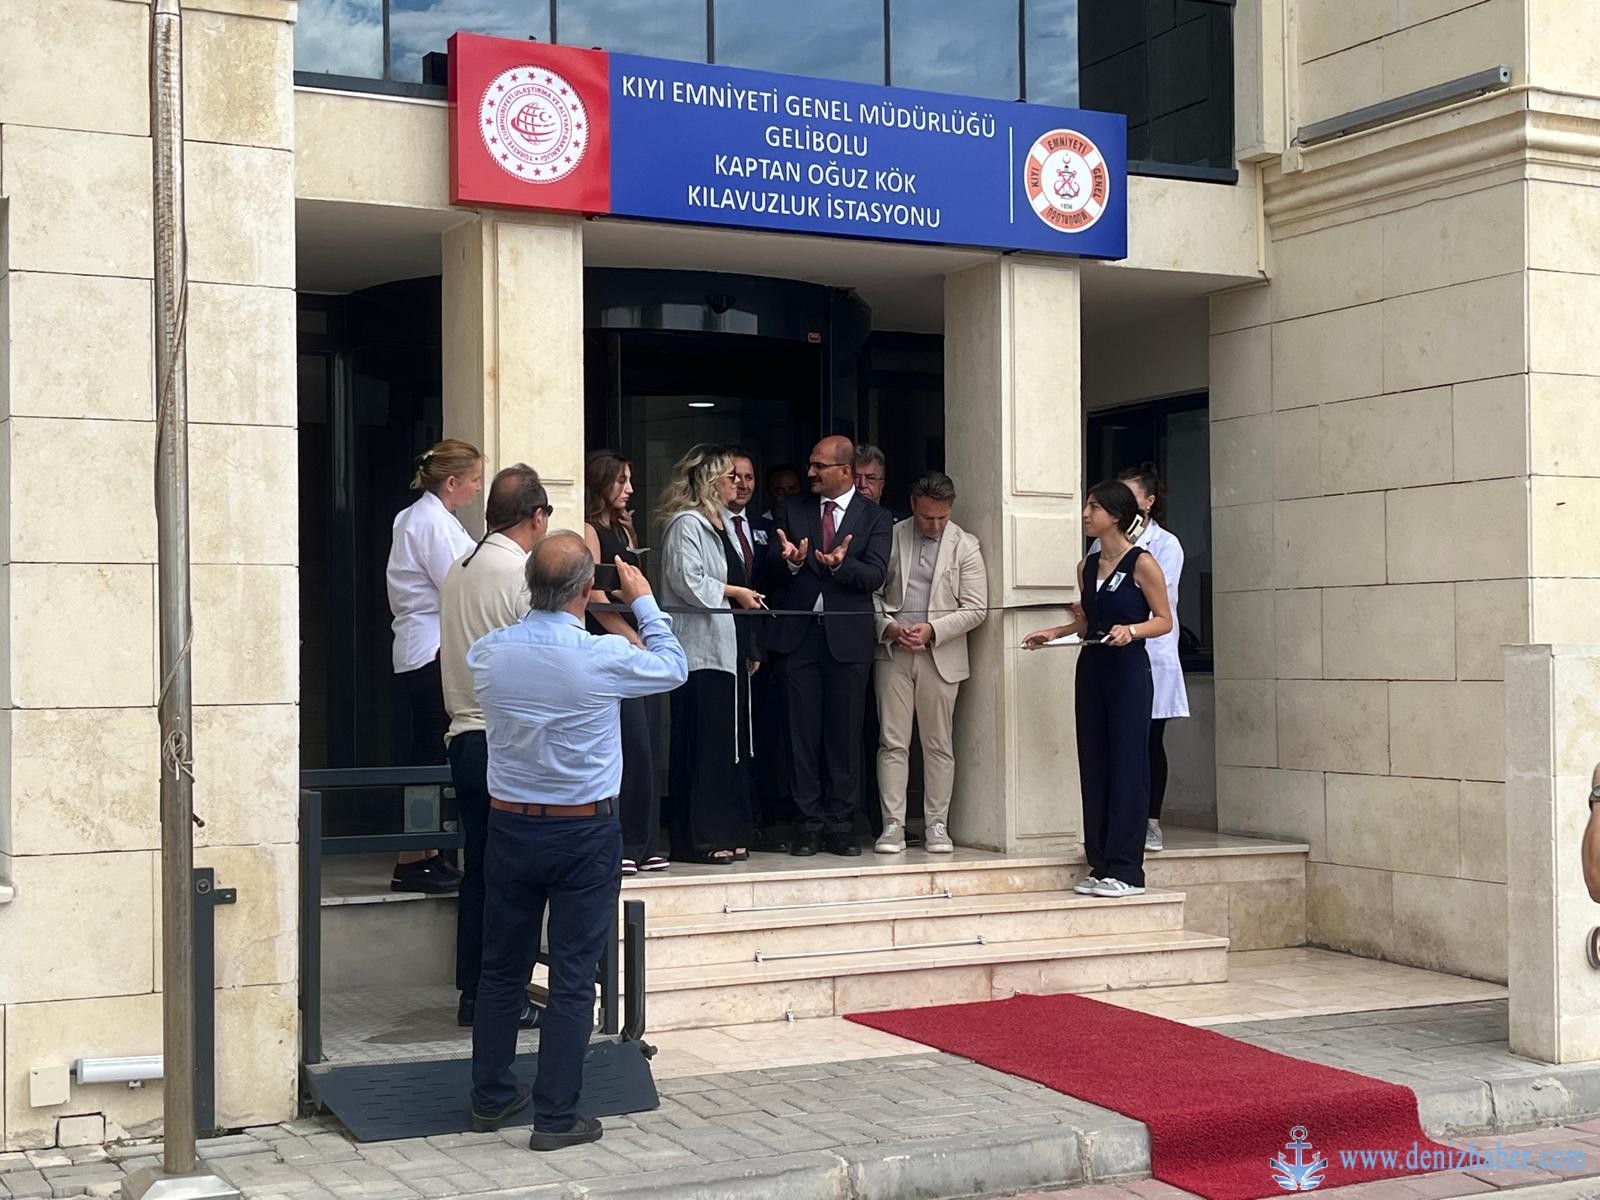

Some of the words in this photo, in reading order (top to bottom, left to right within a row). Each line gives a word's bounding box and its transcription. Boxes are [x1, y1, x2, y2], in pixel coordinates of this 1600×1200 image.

[622, 75, 664, 99] KIYI
[673, 81, 778, 114] EMNİYETİ
[785, 95, 853, 122] GENEL
[859, 101, 996, 138] MÜDÜRLÜĞÜ
[765, 124, 869, 157] GELİBOLU
[715, 154, 800, 183] KAPTAN
[808, 161, 869, 189] OĞUZ
[875, 167, 917, 194] KÖK
[1031, 167, 1040, 188] KIYI
[1092, 167, 1102, 198] GENEL
[688, 185, 820, 220] KILAVUZLUK
[826, 193, 941, 228] İSTASYONU
